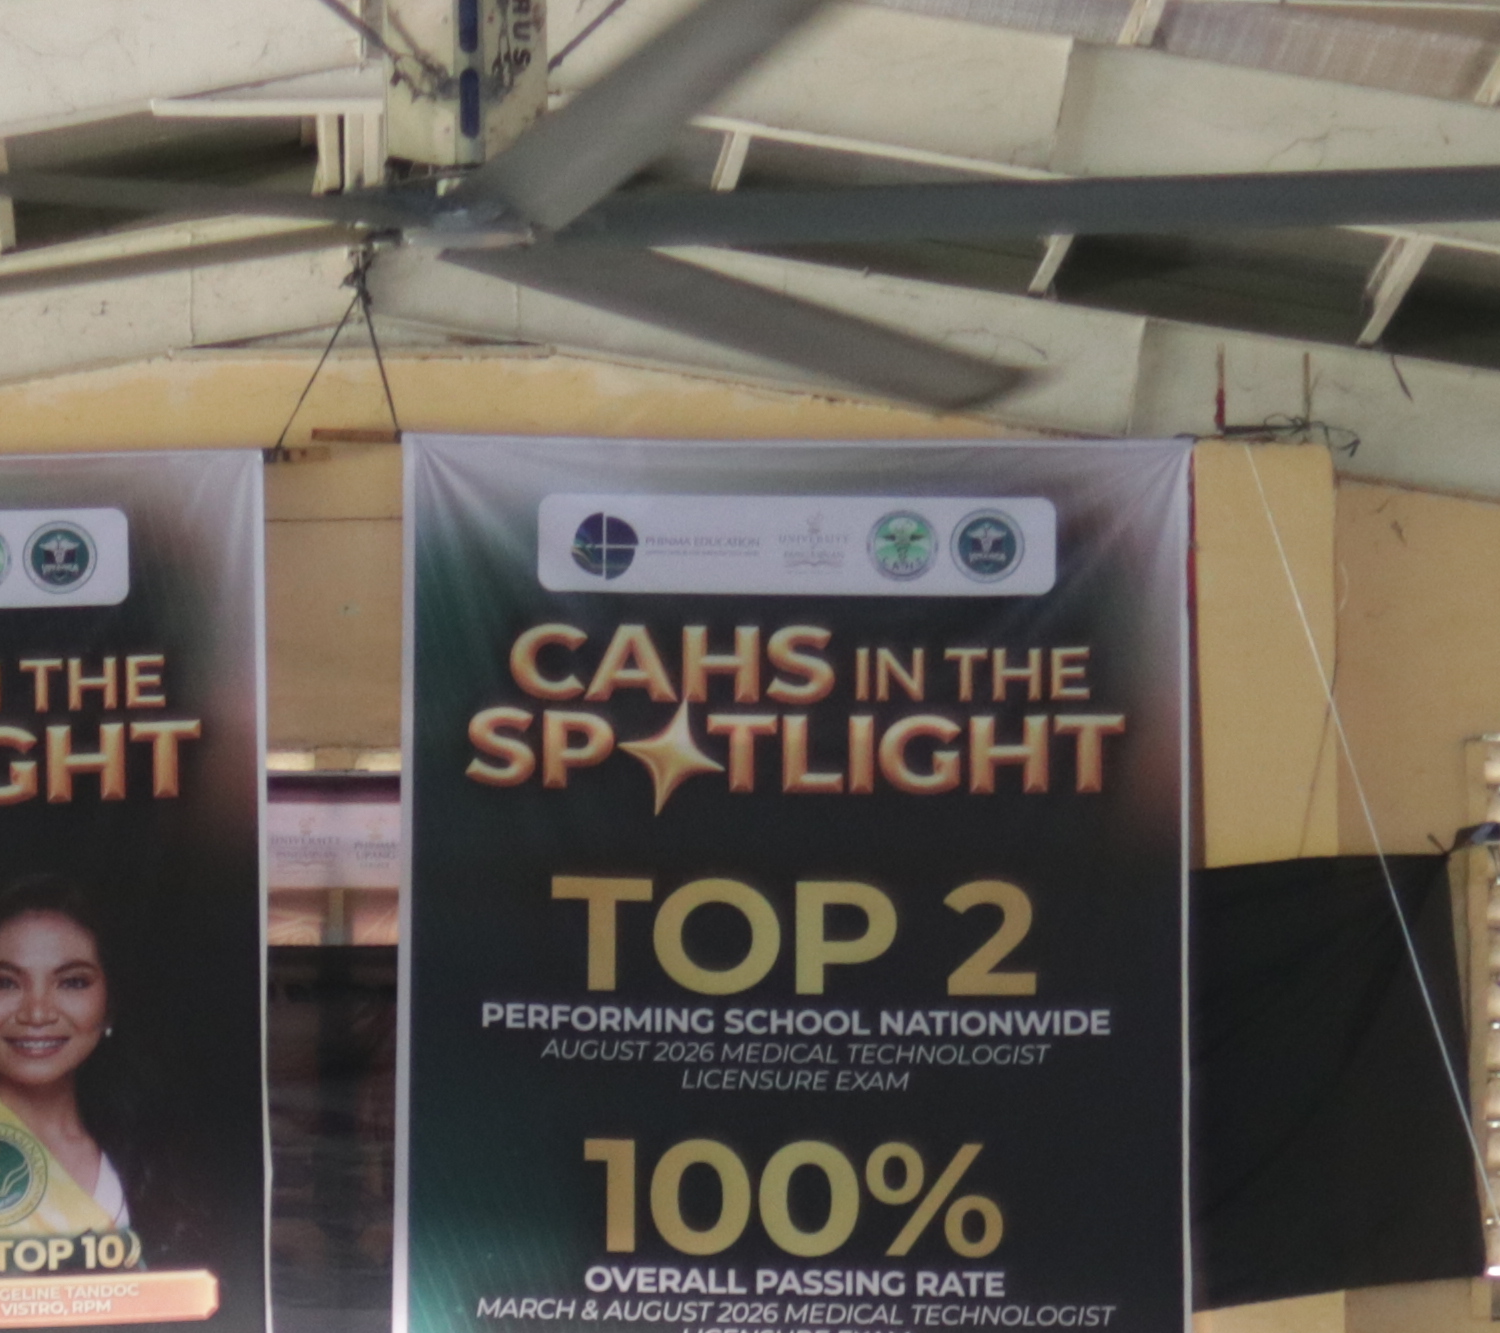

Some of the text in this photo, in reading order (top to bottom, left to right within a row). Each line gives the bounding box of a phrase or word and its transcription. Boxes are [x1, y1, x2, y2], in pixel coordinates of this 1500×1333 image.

[509, 624, 1090, 703] CAHS IN THE
[21, 654, 166, 710] THE
[551, 875, 1036, 996] TOP 2
[481, 1002, 1110, 1037] PERFORMING SCHOOL NATIONWIDE
[542, 1039, 1051, 1066] AUGUST 2026 MEDICAL TECHNOLOGIST
[681, 1068, 910, 1092] LICENSURE EXAM
[583, 1139, 1004, 1259] 100%
[80, 1235, 124, 1270] 10
[65, 1283, 139, 1298] TANDOC
[584, 1267, 1005, 1297] OVERALL PASSING RATE
[0, 1298, 111, 1317] VISTRO, RPM
[477, 1298, 1115, 1326] MARCH & AUGUST 2026 MEDICAL TECHNOLOGIST
